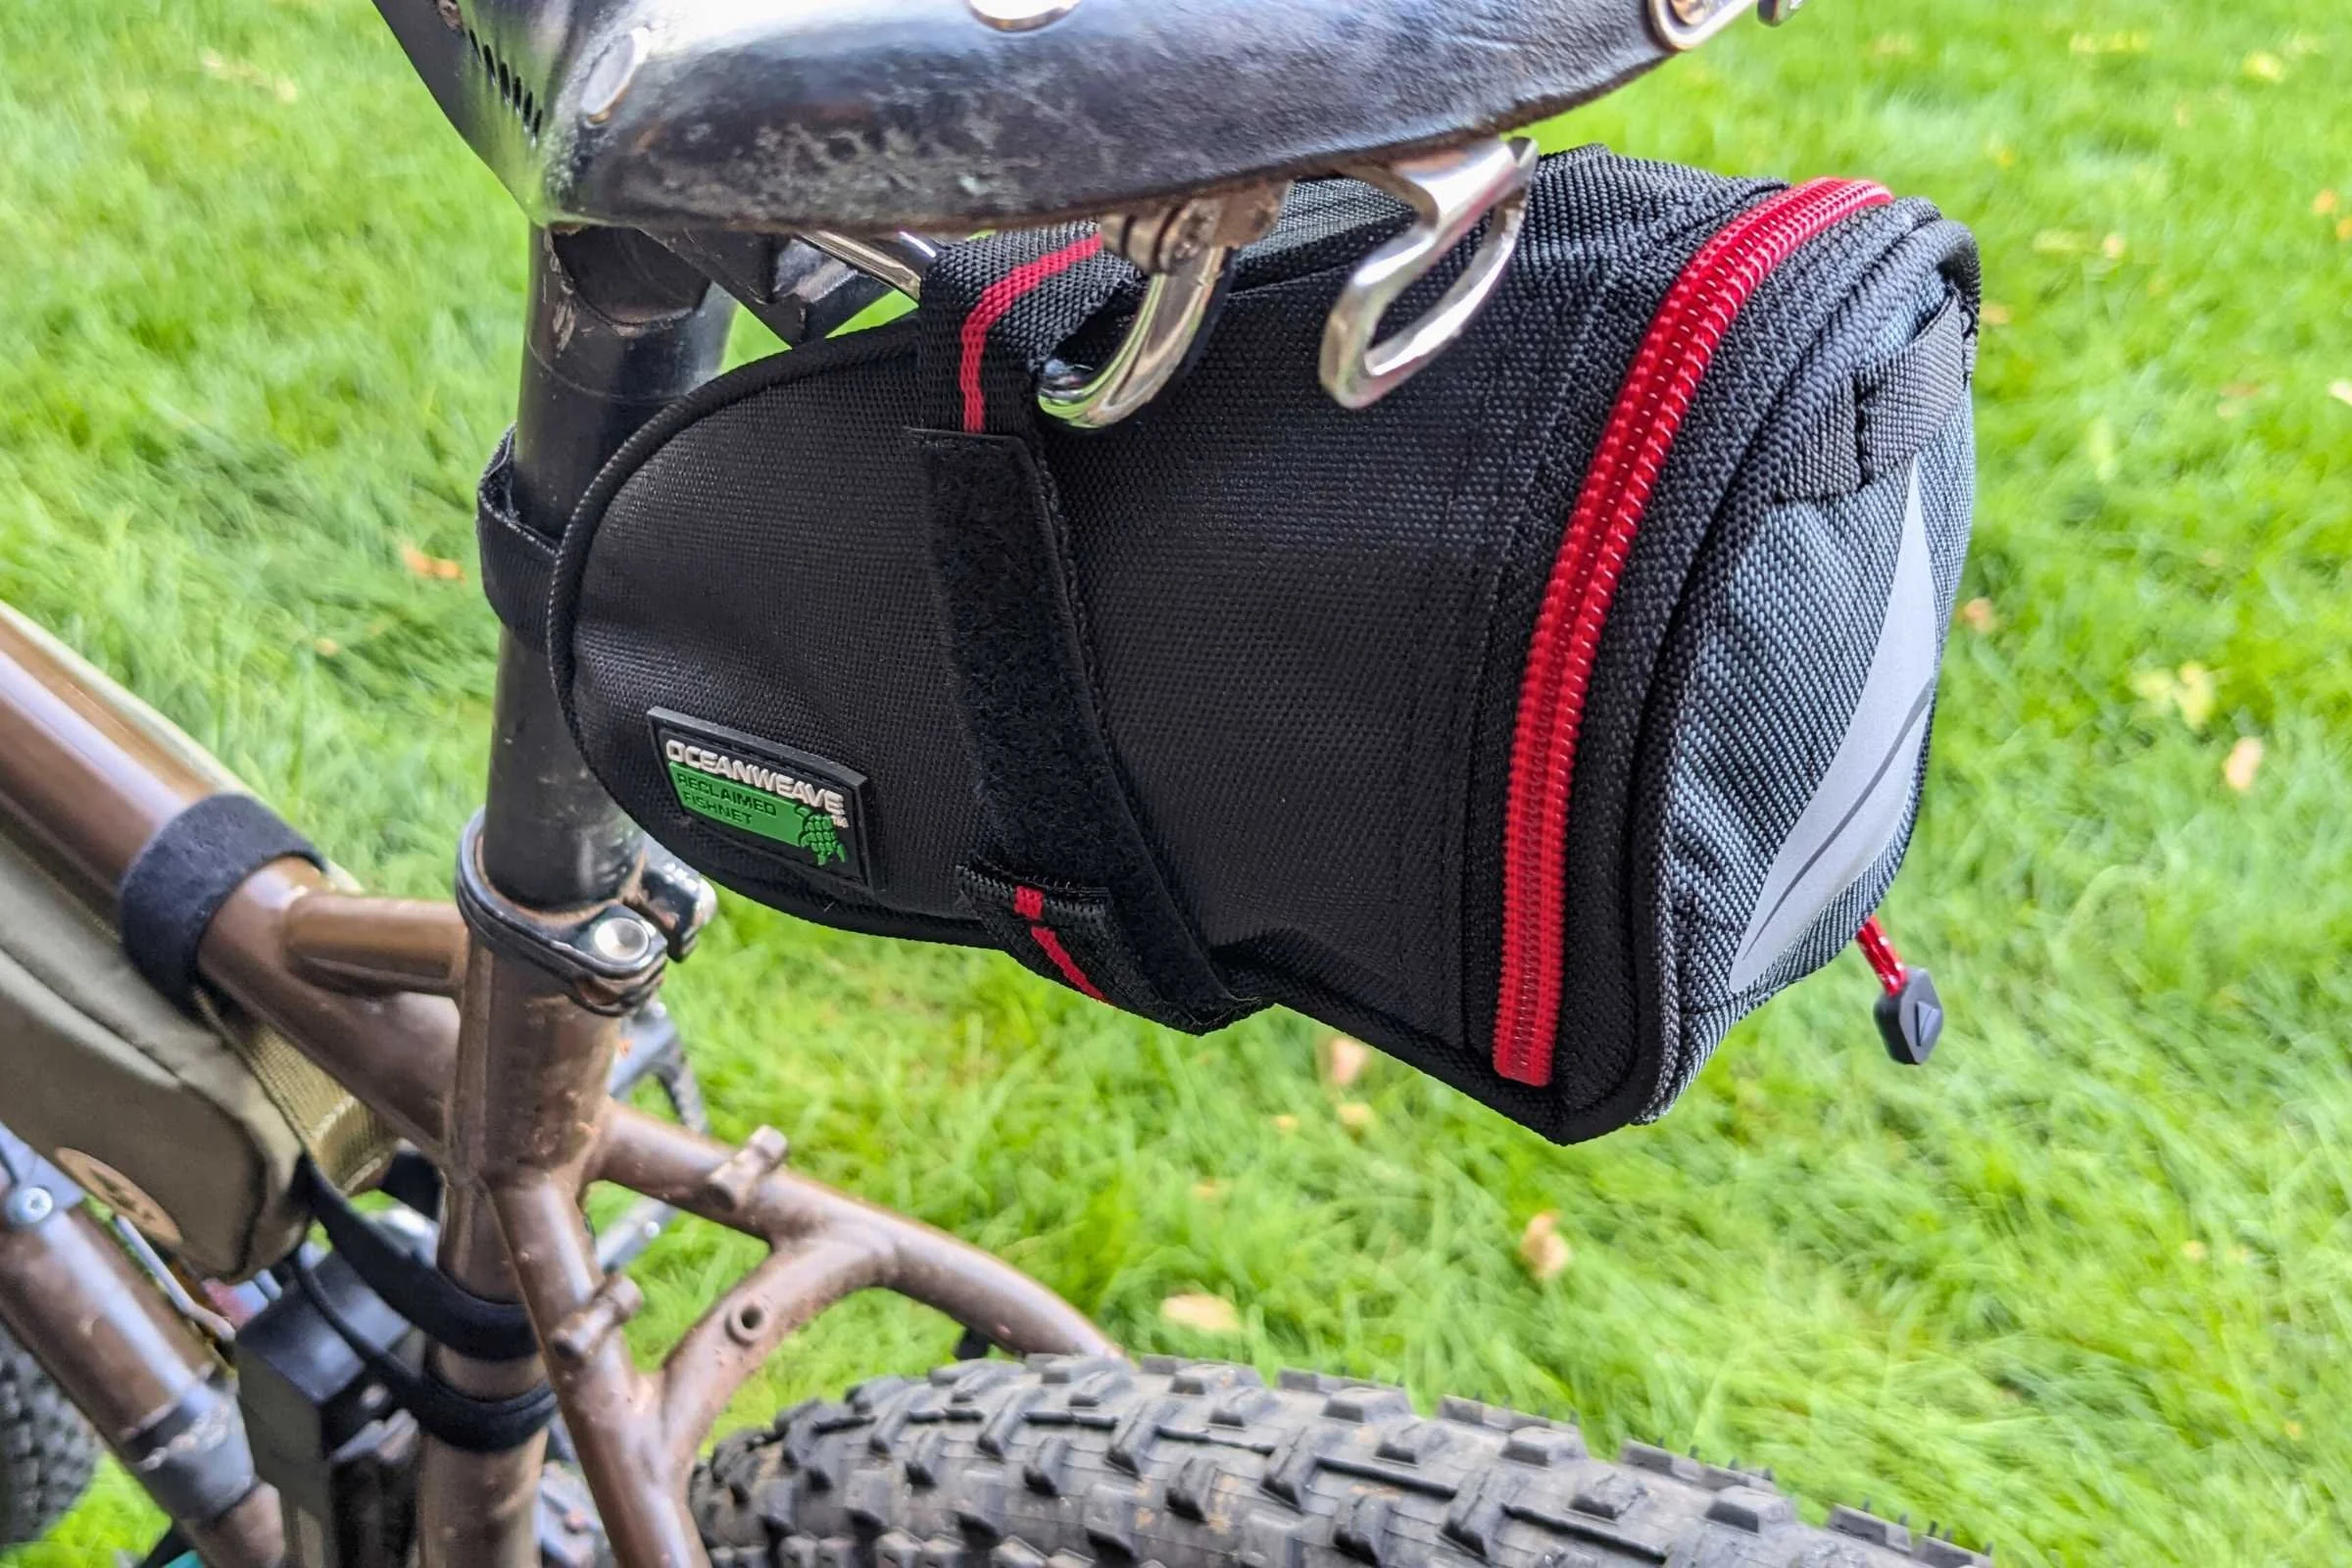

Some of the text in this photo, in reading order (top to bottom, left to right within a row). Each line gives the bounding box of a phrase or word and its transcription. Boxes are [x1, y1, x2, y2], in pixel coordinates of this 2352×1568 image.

[666, 739, 846, 814] OCEANWEAVE
[677, 772, 776, 816] RECLAIMED
[683, 791, 753, 824] FISHNET
